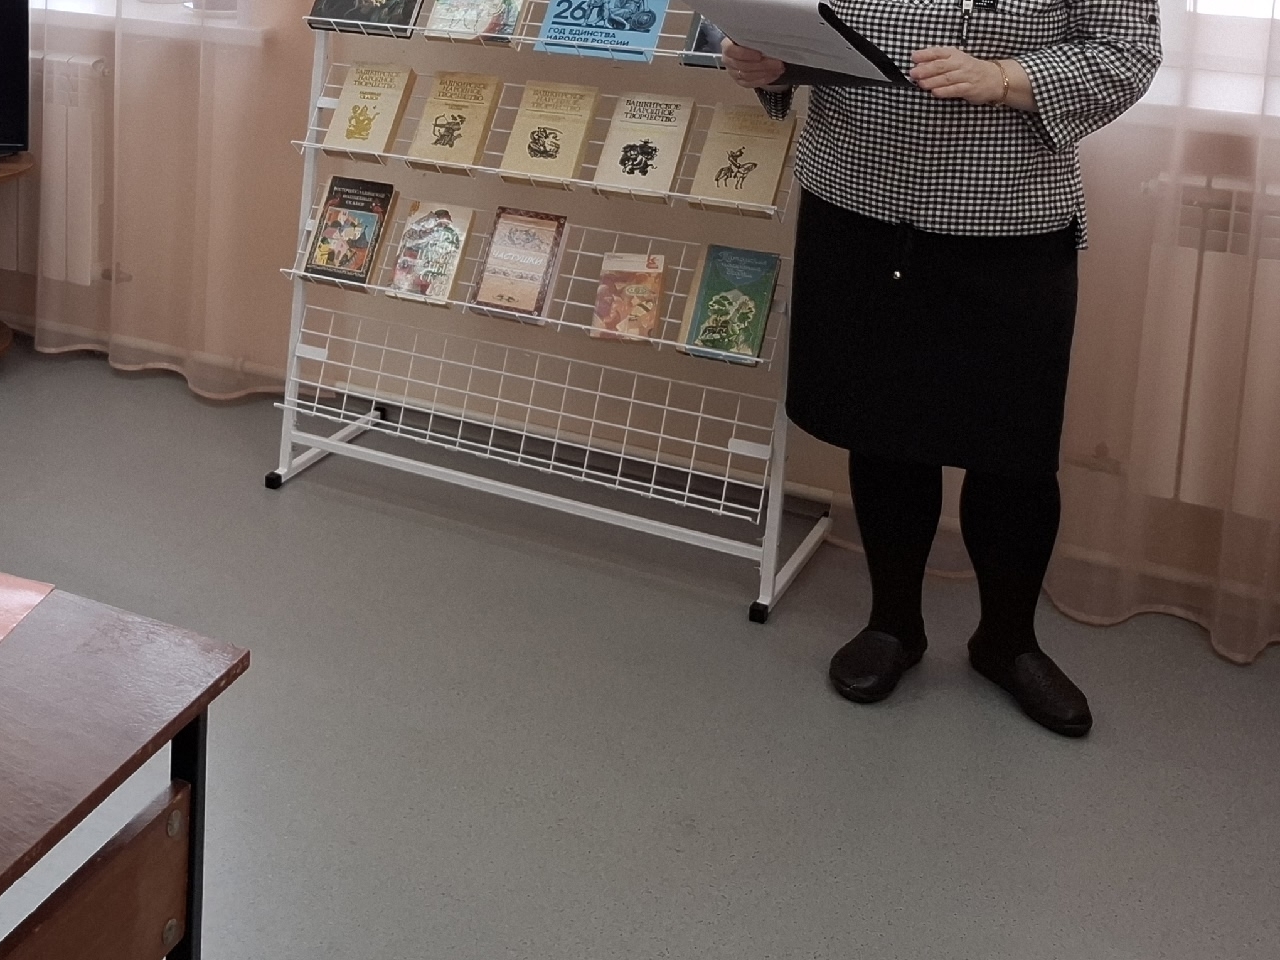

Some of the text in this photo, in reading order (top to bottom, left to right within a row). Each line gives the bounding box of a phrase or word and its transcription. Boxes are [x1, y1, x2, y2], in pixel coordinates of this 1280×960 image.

[548, 27, 617, 38] ГОД ЕДИНСТВА
[546, 34, 630, 46] НАРОДОВ РОССИИ
[626, 100, 681, 110] БАШКИРСКОЕ
[624, 112, 676, 122] ТВОРЧЕСТВО
